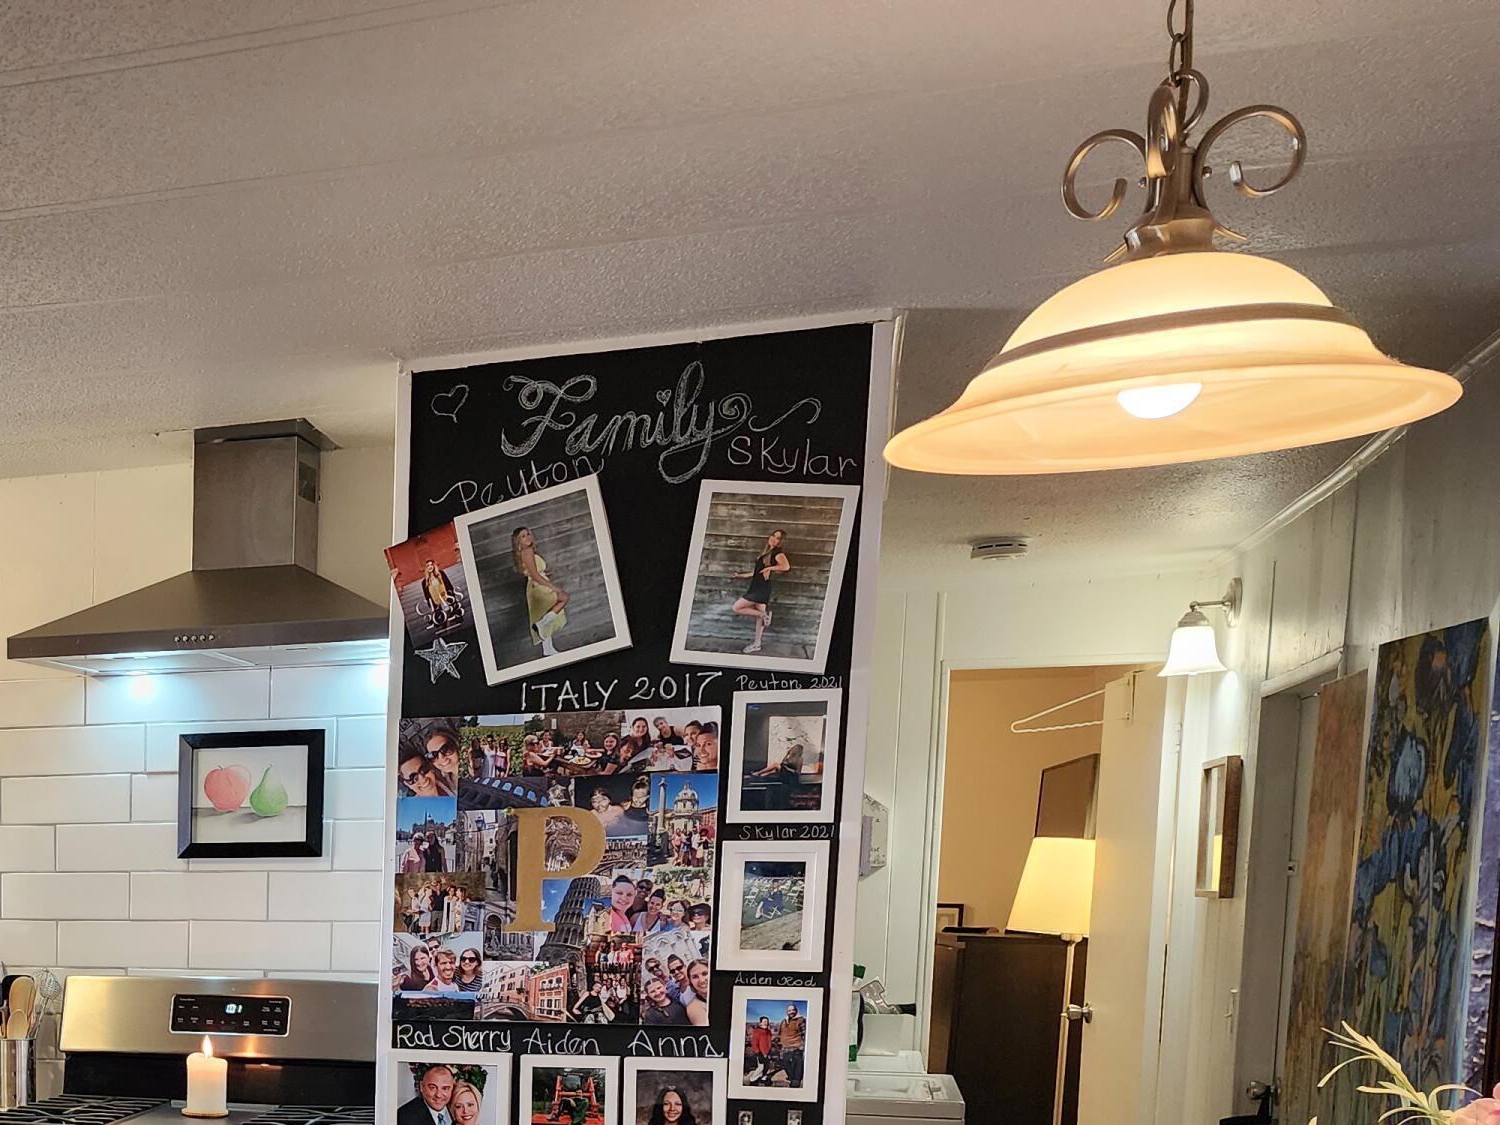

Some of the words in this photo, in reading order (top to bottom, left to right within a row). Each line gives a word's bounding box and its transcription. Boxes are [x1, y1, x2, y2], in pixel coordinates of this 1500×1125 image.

[500, 360, 752, 484] Family
[430, 456, 604, 513] Peyton
[520, 680, 619, 712] ITALY
[628, 670, 724, 708] 2017
[735, 672, 802, 691] Peyton
[809, 675, 843, 690] 2021
[799, 824, 835, 839] 2021
[501, 805, 605, 934] P
[734, 971, 773, 985] Aiden
[396, 1023, 440, 1048] Rod
[442, 1025, 512, 1051] Sherry
[523, 1028, 601, 1055] Aiden
[626, 1029, 725, 1057] Anna
